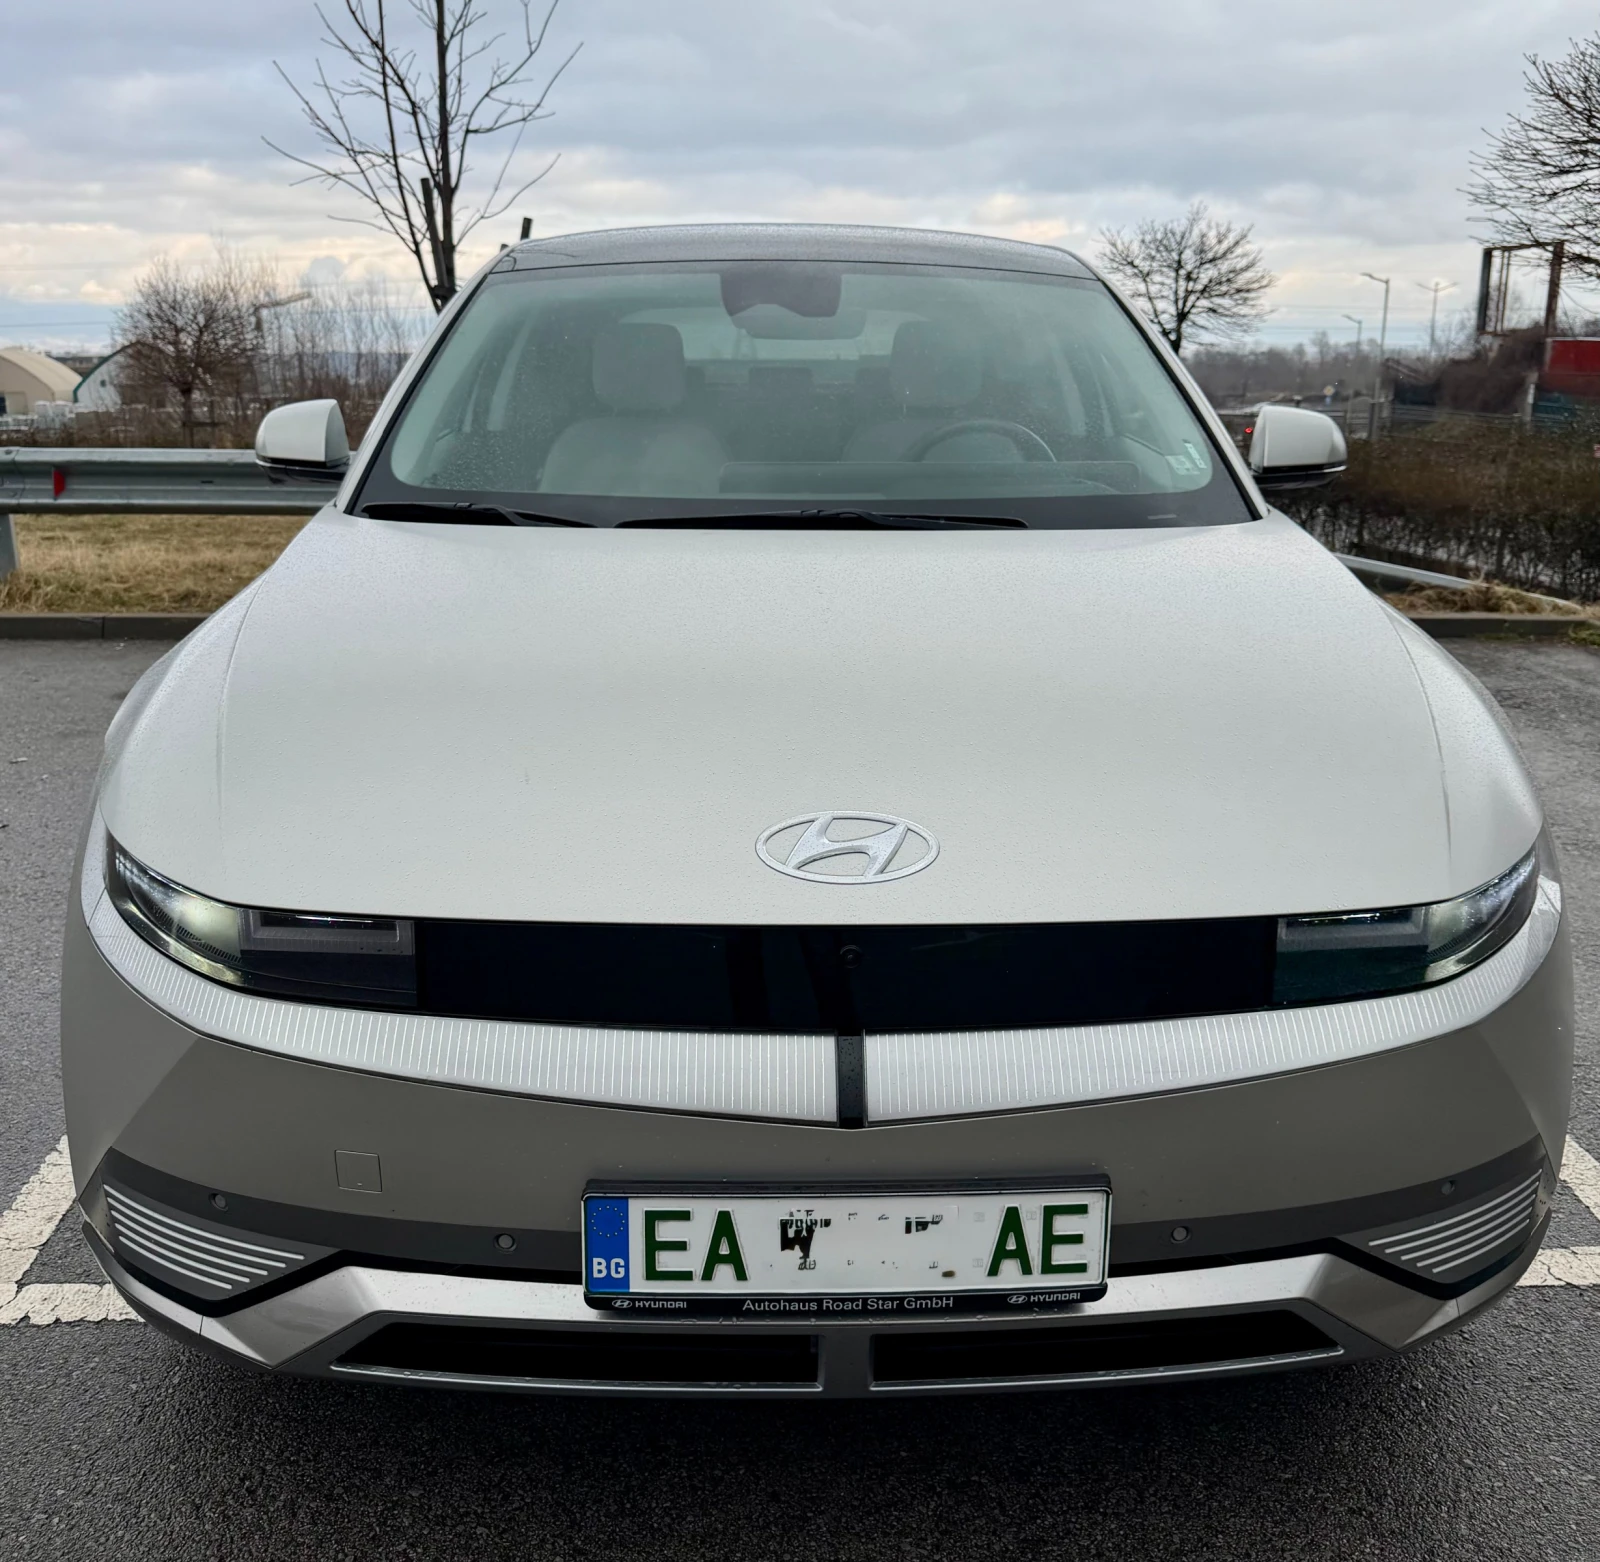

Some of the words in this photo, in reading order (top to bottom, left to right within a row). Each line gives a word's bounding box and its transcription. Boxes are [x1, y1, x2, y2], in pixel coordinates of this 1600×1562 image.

[643, 1209, 749, 1281] EA
[985, 1203, 1089, 1277] AE
[592, 1257, 625, 1279] BG
[635, 1300, 687, 1309] HYUNDAI
[742, 1299, 818, 1311] Autohaus
[823, 1298, 863, 1311] Road
[867, 1298, 900, 1310] Star
[903, 1296, 954, 1309] GmbH
[1030, 1292, 1081, 1302] HYUNDAI
